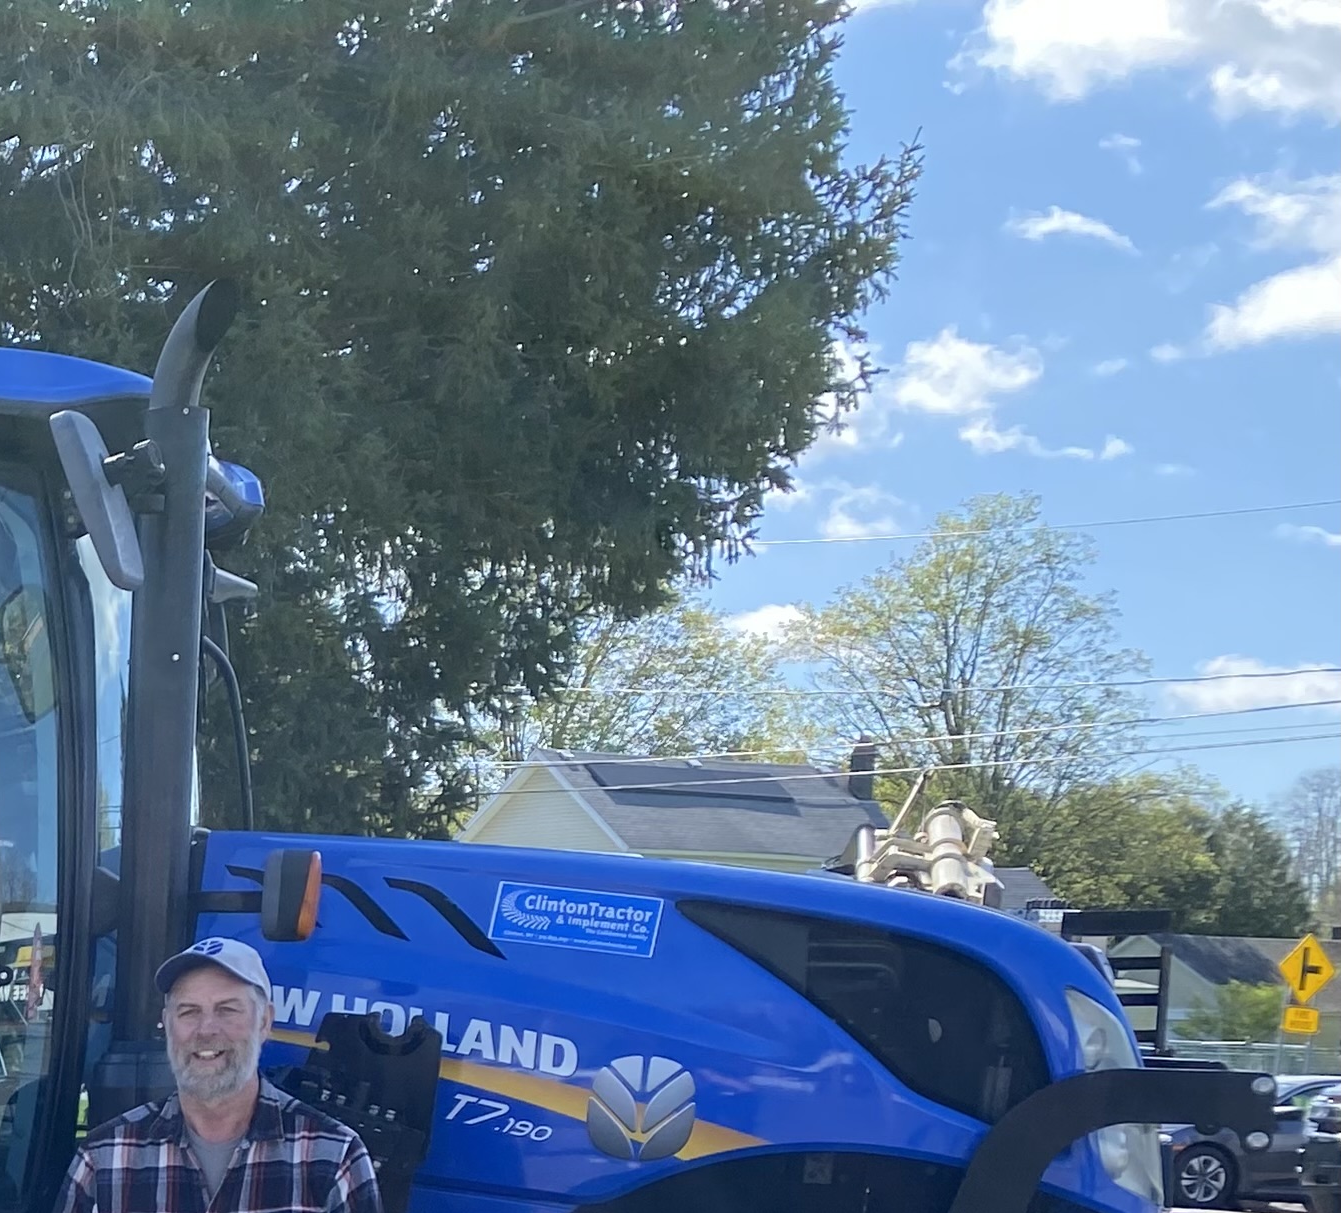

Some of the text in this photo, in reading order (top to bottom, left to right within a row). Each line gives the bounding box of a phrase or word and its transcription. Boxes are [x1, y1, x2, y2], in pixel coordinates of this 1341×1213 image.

[524, 894, 654, 923] ClintonTractor
[555, 914, 650, 934] & Implement Co.
[331, 993, 579, 1078] HOLAND
